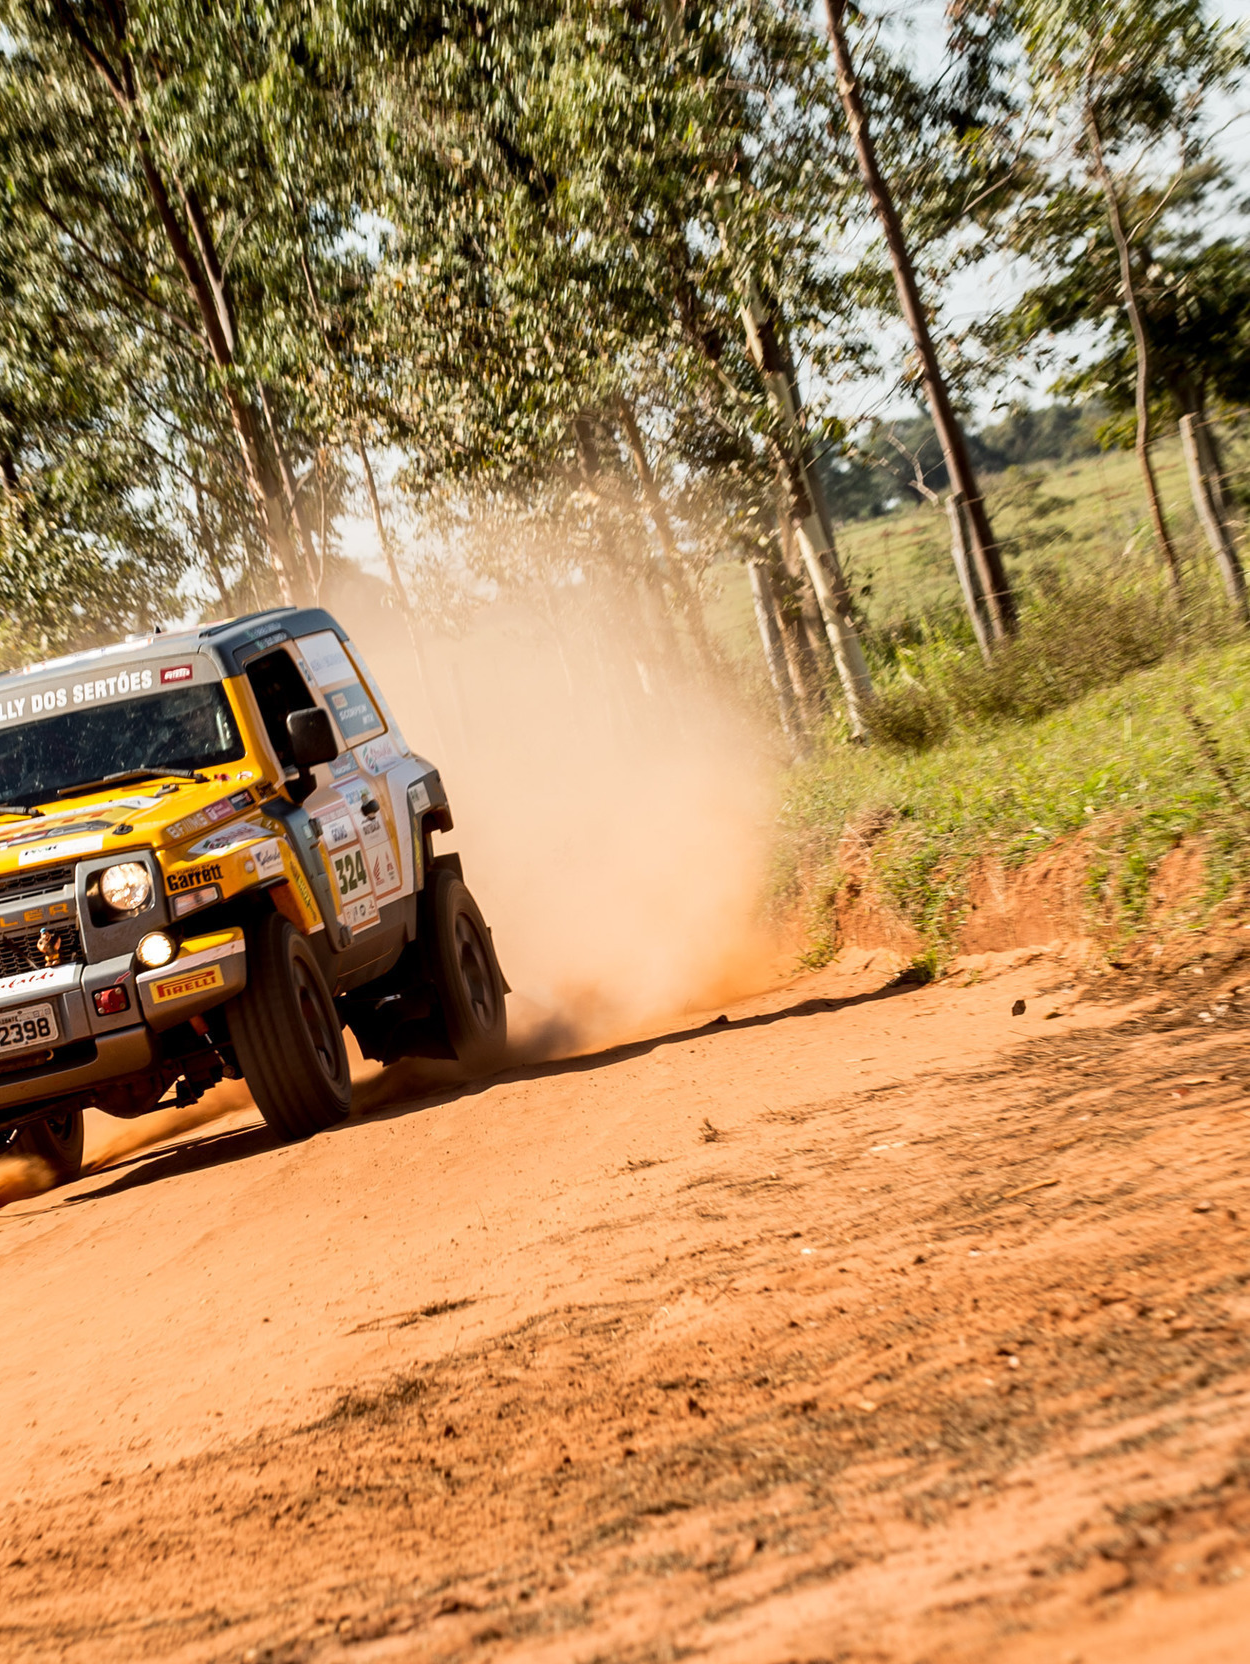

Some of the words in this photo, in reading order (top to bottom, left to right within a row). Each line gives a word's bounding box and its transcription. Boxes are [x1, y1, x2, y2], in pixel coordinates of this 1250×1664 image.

[31, 688, 67, 713] DOS
[72, 670, 152, 704] SERTÕES
[166, 864, 224, 892] Garrett
[334, 850, 367, 894] 324
[156, 970, 217, 998] PIRELLI
